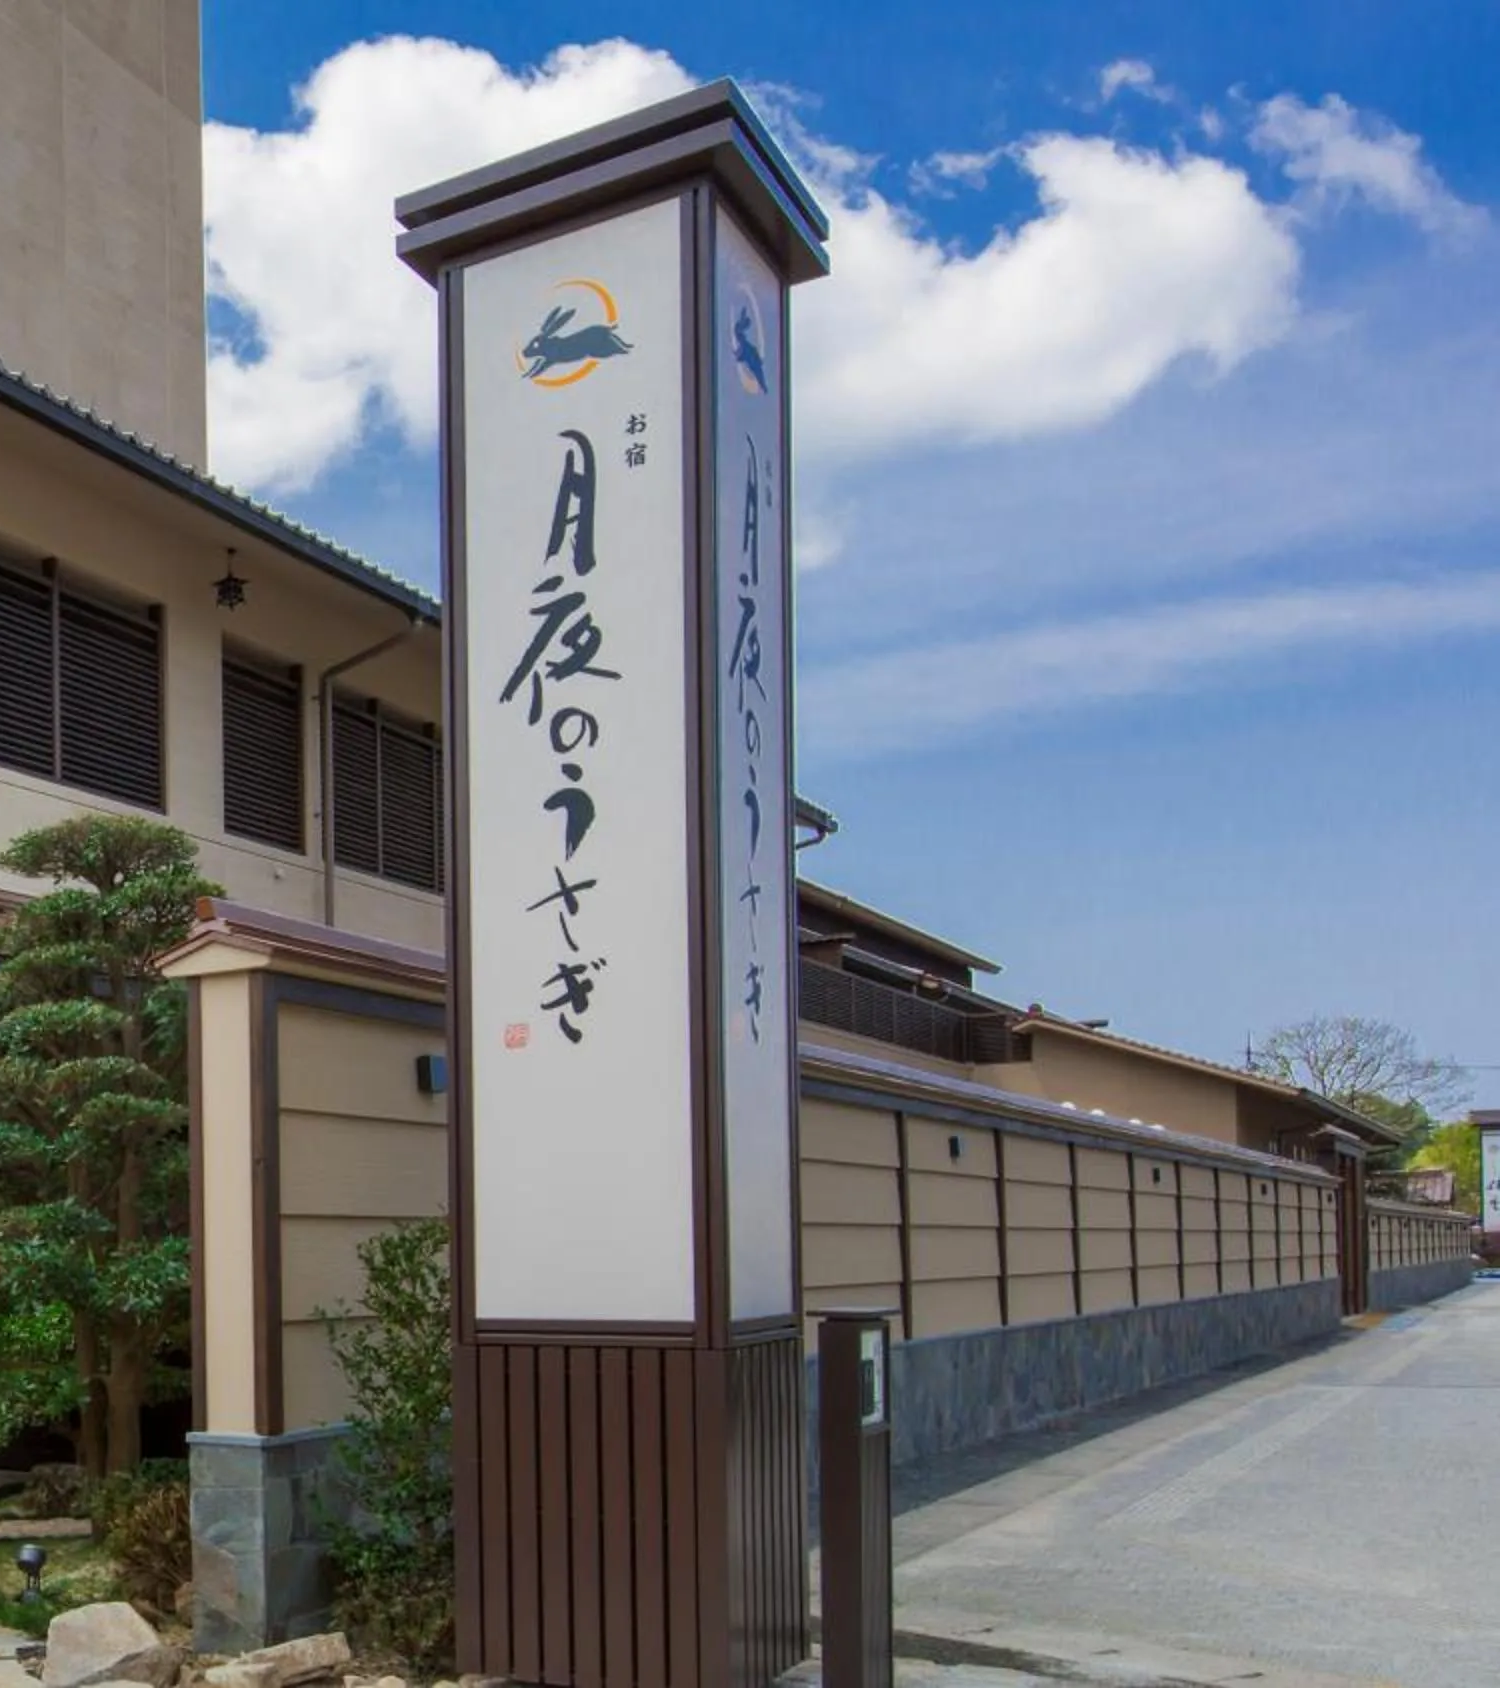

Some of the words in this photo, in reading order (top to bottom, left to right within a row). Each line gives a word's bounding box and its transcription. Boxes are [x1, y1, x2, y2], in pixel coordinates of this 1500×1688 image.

[499, 428, 623, 1044] 月夜のうさぎ
[624, 413, 647, 468] お宿
[729, 432, 767, 1044] 月夜のうさぎ
